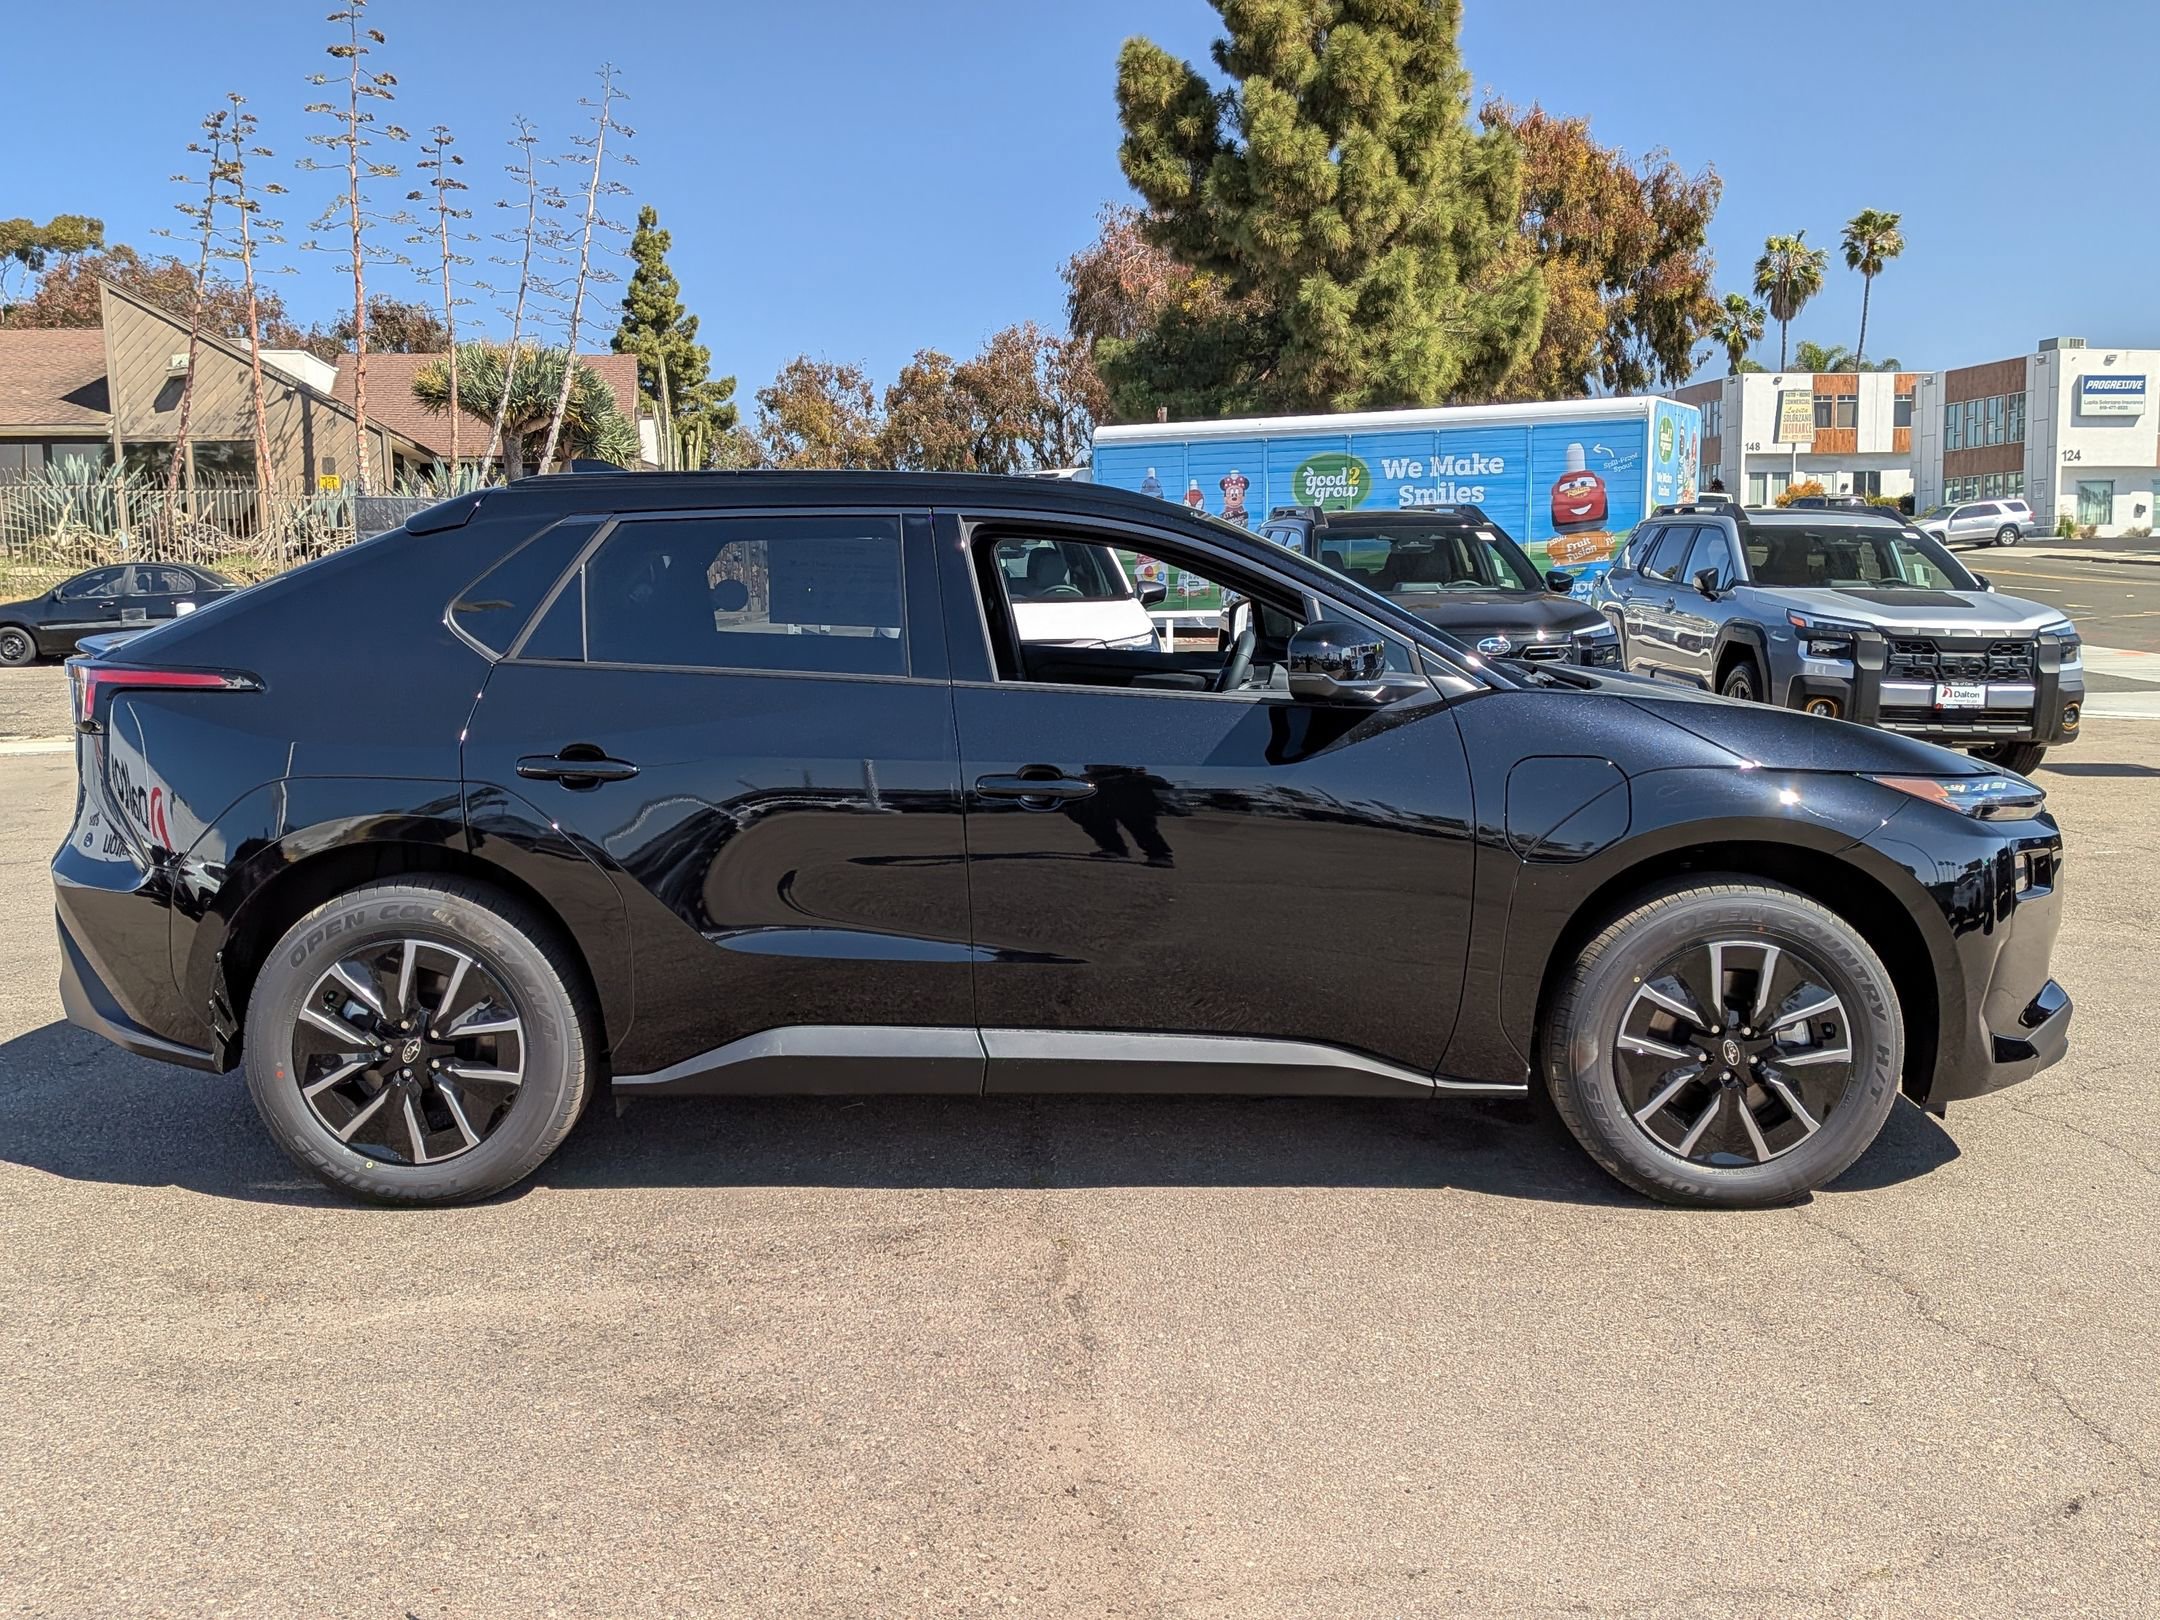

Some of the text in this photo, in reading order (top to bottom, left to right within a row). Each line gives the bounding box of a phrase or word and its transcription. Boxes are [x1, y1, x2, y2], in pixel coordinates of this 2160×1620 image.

[2085, 380, 2144, 390] PROGRESSIVE
[1783, 423, 1812, 434] INSURANCE
[1745, 442, 1760, 451] 148
[2061, 450, 2081, 461] 124
[1382, 453, 1504, 479] We Make
[1314, 486, 1359, 506] grow
[1399, 482, 1485, 506] Smiles
[1567, 537, 1591, 552] Fruit
[1566, 544, 1597, 562] Fusion
[1954, 690, 1980, 698] Dalton
[289, 910, 365, 969] OPEN
[1670, 904, 1890, 1107] OPEN COUNTRY H/T
